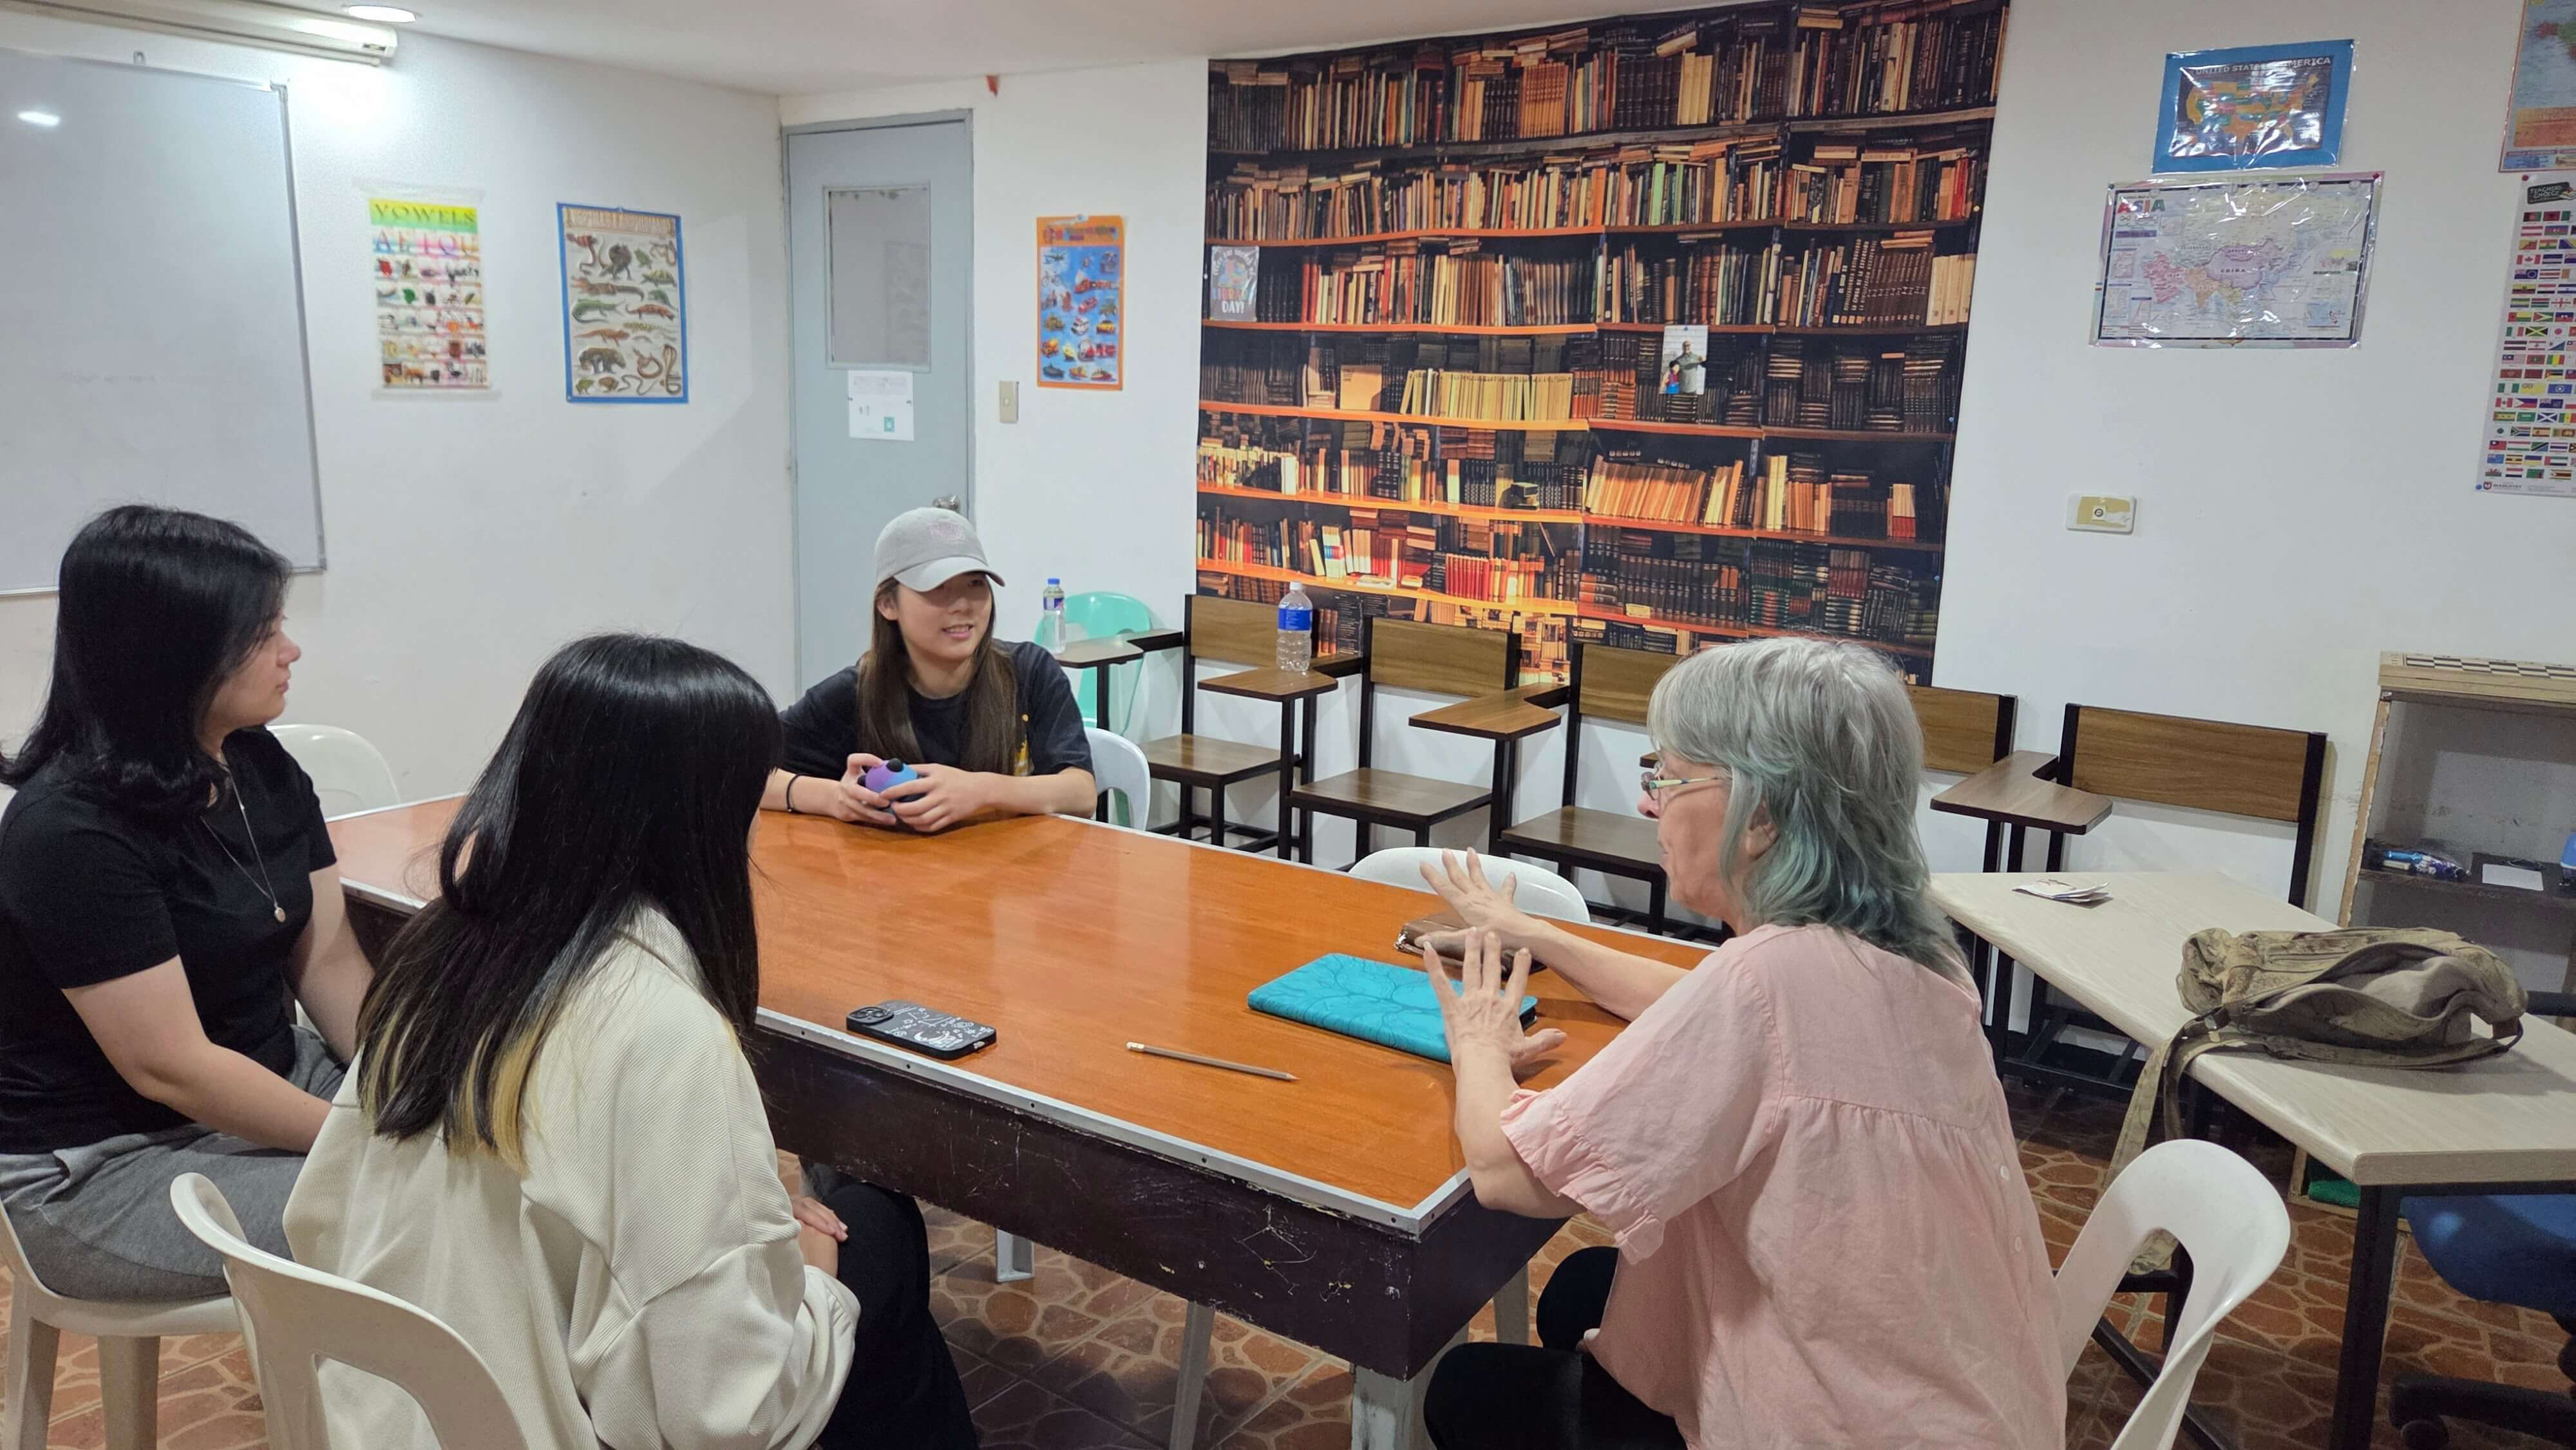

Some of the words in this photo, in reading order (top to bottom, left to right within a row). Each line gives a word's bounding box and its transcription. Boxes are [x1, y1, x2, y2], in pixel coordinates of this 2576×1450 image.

[2195, 66, 2230, 75] UNITED
[375, 203, 477, 224] VOWELS
[2117, 199, 2165, 214] ASIA
[1222, 301, 1244, 314] DAY!
